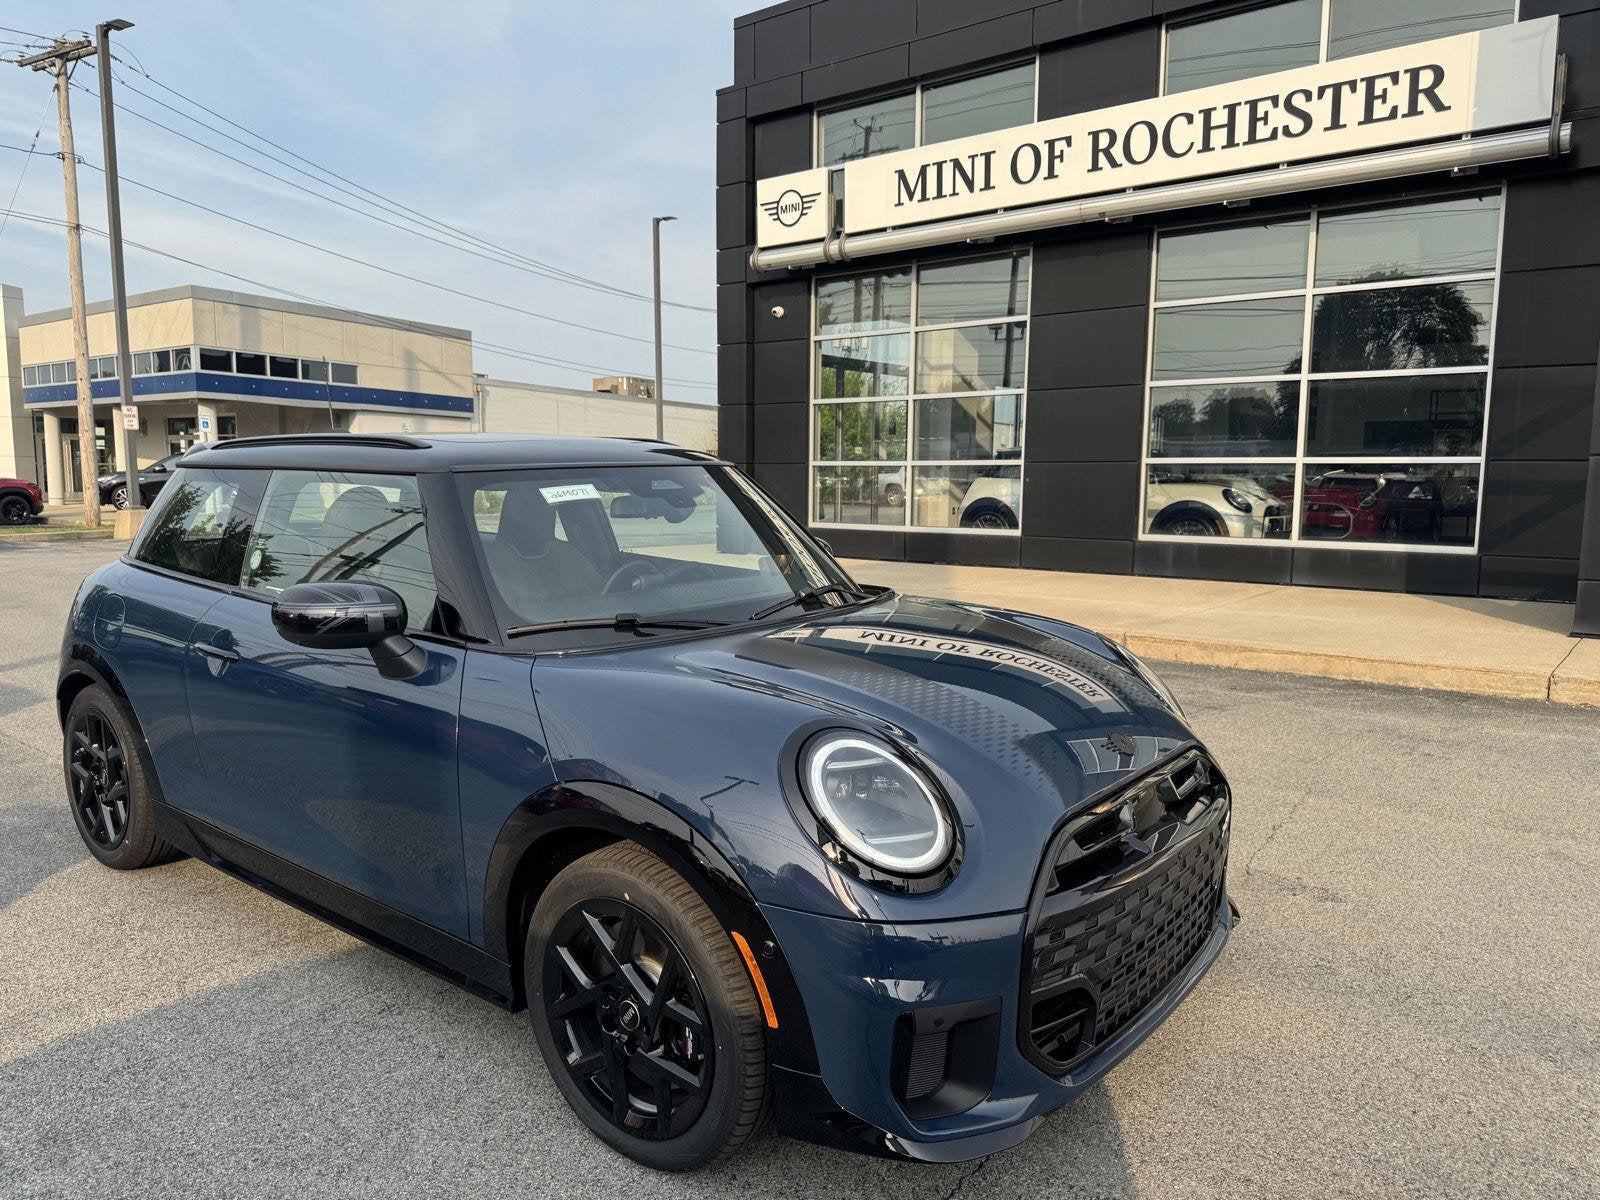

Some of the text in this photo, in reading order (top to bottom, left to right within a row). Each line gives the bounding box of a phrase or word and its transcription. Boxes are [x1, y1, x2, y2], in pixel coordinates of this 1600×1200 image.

[895, 63, 1452, 207] MINI OF ROCHESTER
[780, 202, 800, 215] MINI
